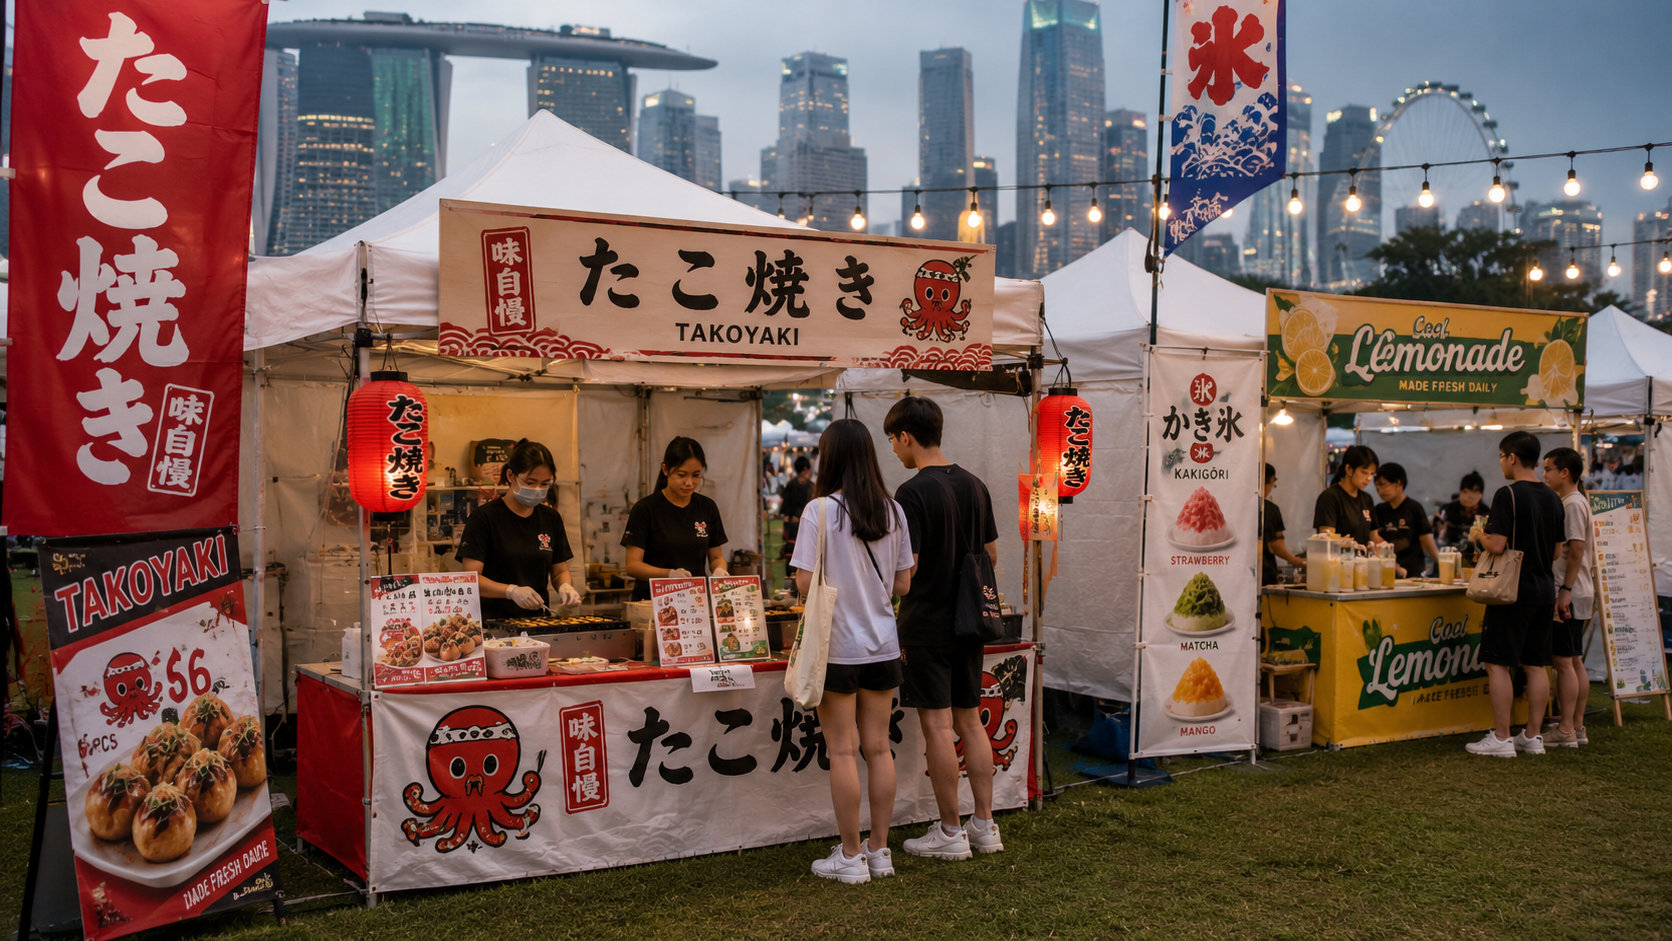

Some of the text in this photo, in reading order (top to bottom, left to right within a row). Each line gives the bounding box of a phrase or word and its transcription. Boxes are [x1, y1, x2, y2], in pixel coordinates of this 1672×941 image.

[1187, 5, 1270, 107] 氷
[56, 11, 190, 486] たこ焼き
[491, 237, 527, 327] 味自慢
[579, 236, 875, 321] たこ焼き
[675, 322, 799, 346] TAKOYAKI
[1162, 405, 1245, 443] かき氷
[1399, 379, 1497, 393] MADE FRESH DAILY
[156, 393, 206, 491] 味自慢
[386, 394, 424, 500] たこ焼き
[1063, 406, 1091, 488] たこ焼き
[54, 534, 229, 633] TAKOYAKI
[1171, 555, 1230, 566] STRAWBERRY
[1180, 641, 1219, 651] MATCHA
[568, 712, 601, 803] 味自慢
[1180, 725, 1216, 737] MANGO
